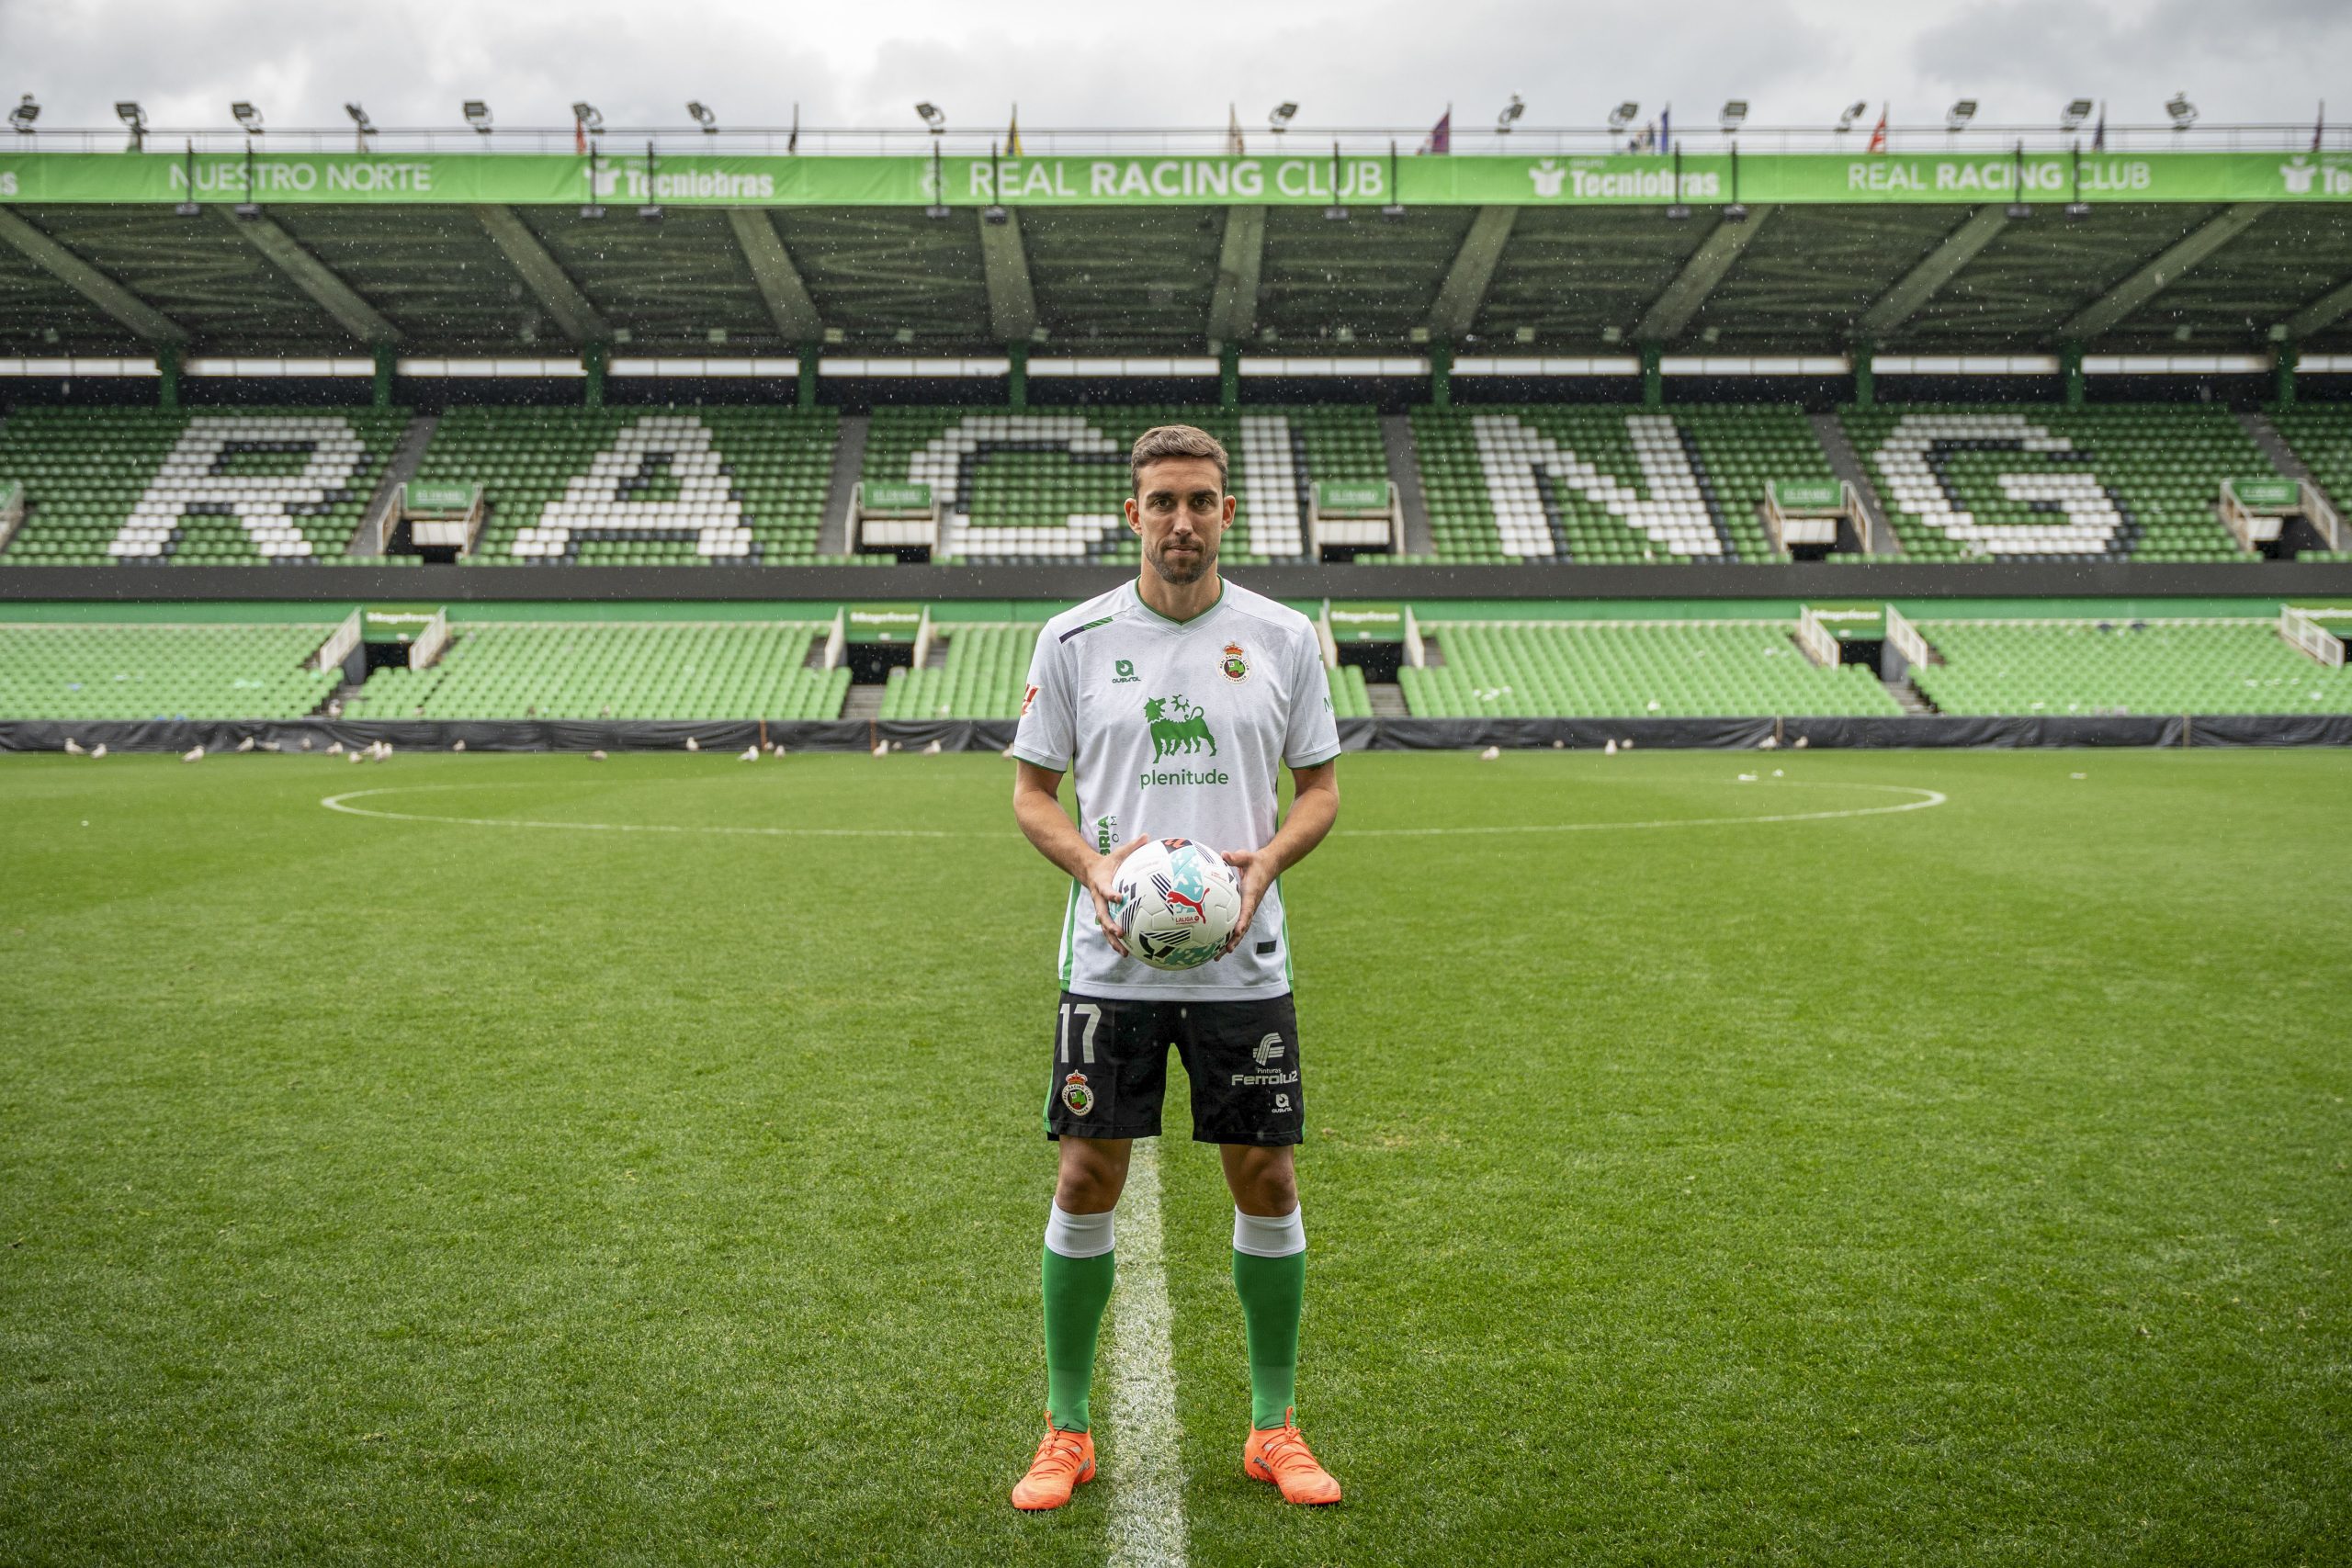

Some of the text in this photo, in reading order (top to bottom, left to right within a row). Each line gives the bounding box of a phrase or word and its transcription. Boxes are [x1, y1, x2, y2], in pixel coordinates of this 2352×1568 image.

[169, 163, 432, 191] NUESTRO NORTE
[970, 161, 1384, 197] REAL RACING CLUB
[1571, 168, 1720, 197] Tecniobras
[1848, 162, 2151, 190] REAL RACING CLUB
[1140, 768, 1229, 789] plenitude
[1059, 1003, 1102, 1064] 17
